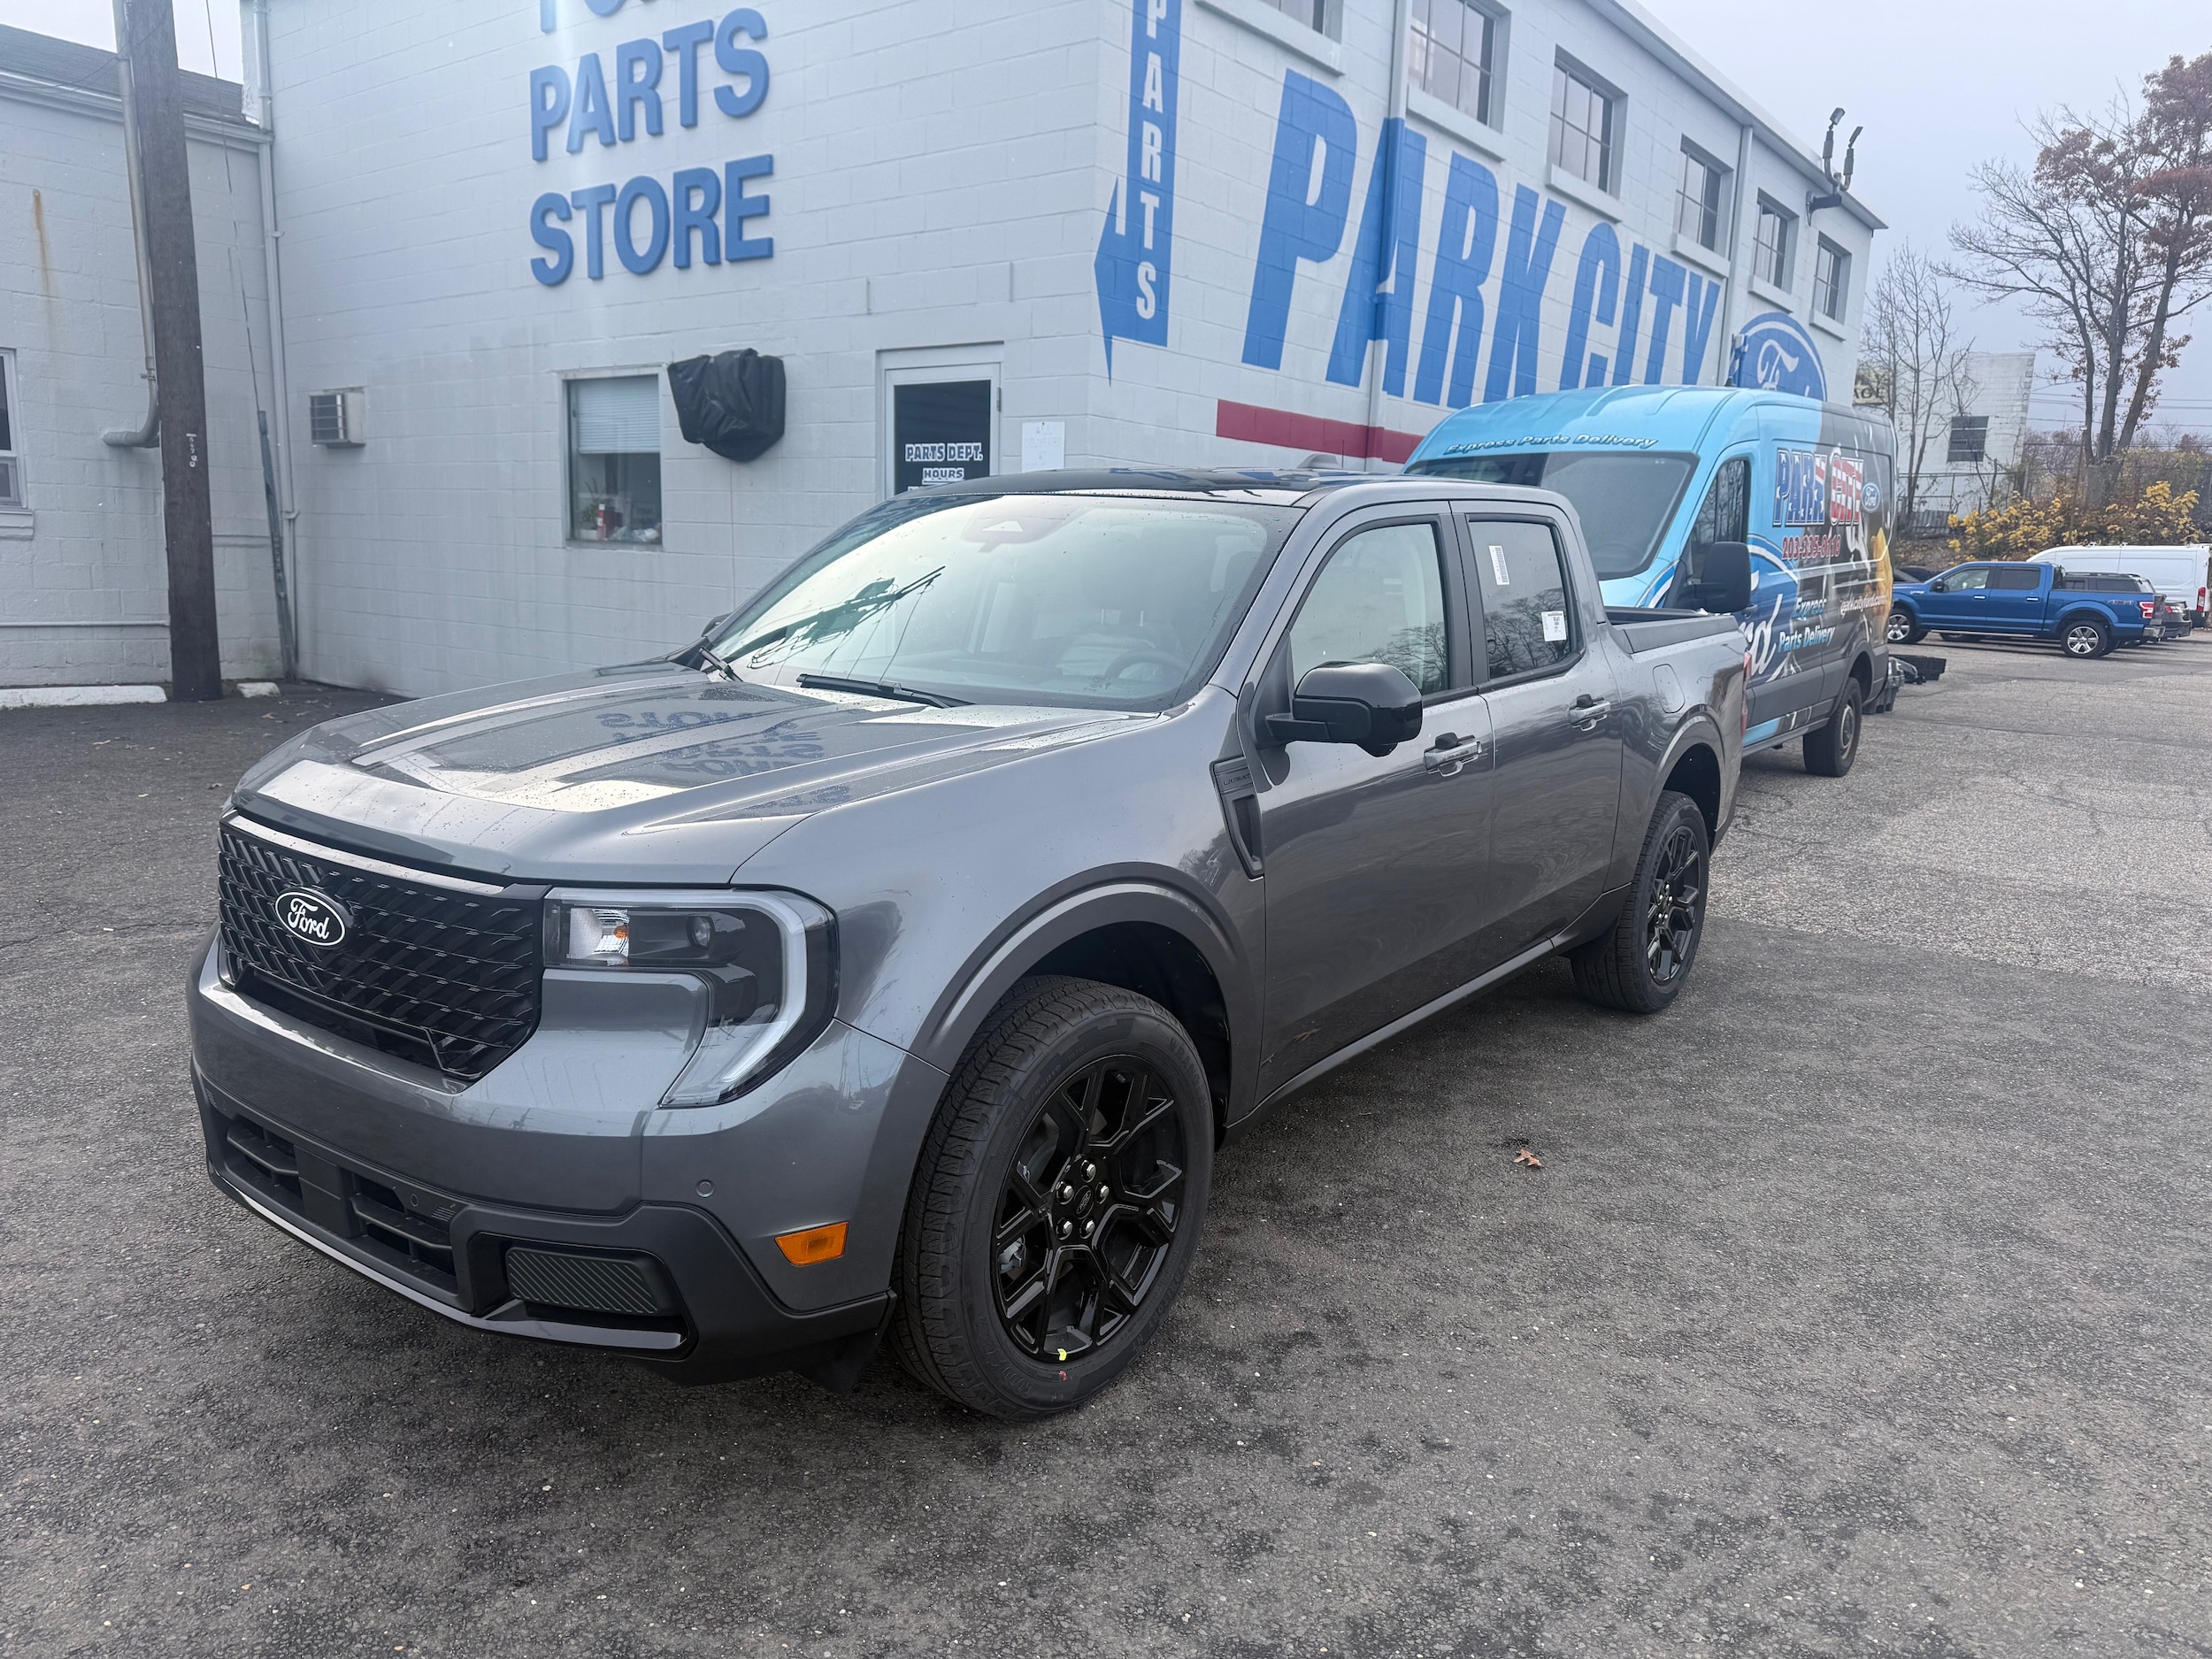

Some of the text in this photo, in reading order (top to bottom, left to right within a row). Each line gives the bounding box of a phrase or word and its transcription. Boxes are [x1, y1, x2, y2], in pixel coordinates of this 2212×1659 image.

[530, 8, 770, 163] PARTS
[1136, 0, 1167, 319] PARTS
[530, 154, 773, 287] STORE
[1241, 68, 1720, 409] PARK CITY
[905, 442, 984, 462] PARTS DEPT.
[1442, 434, 1660, 455] Express Parts Delivery
[922, 467, 965, 480] HOURS
[1772, 447, 1864, 527] PARK CITY
[1792, 597, 1827, 618] Express
[1778, 625, 1836, 653] Parts Delivery
[288, 898, 330, 940] Ford
